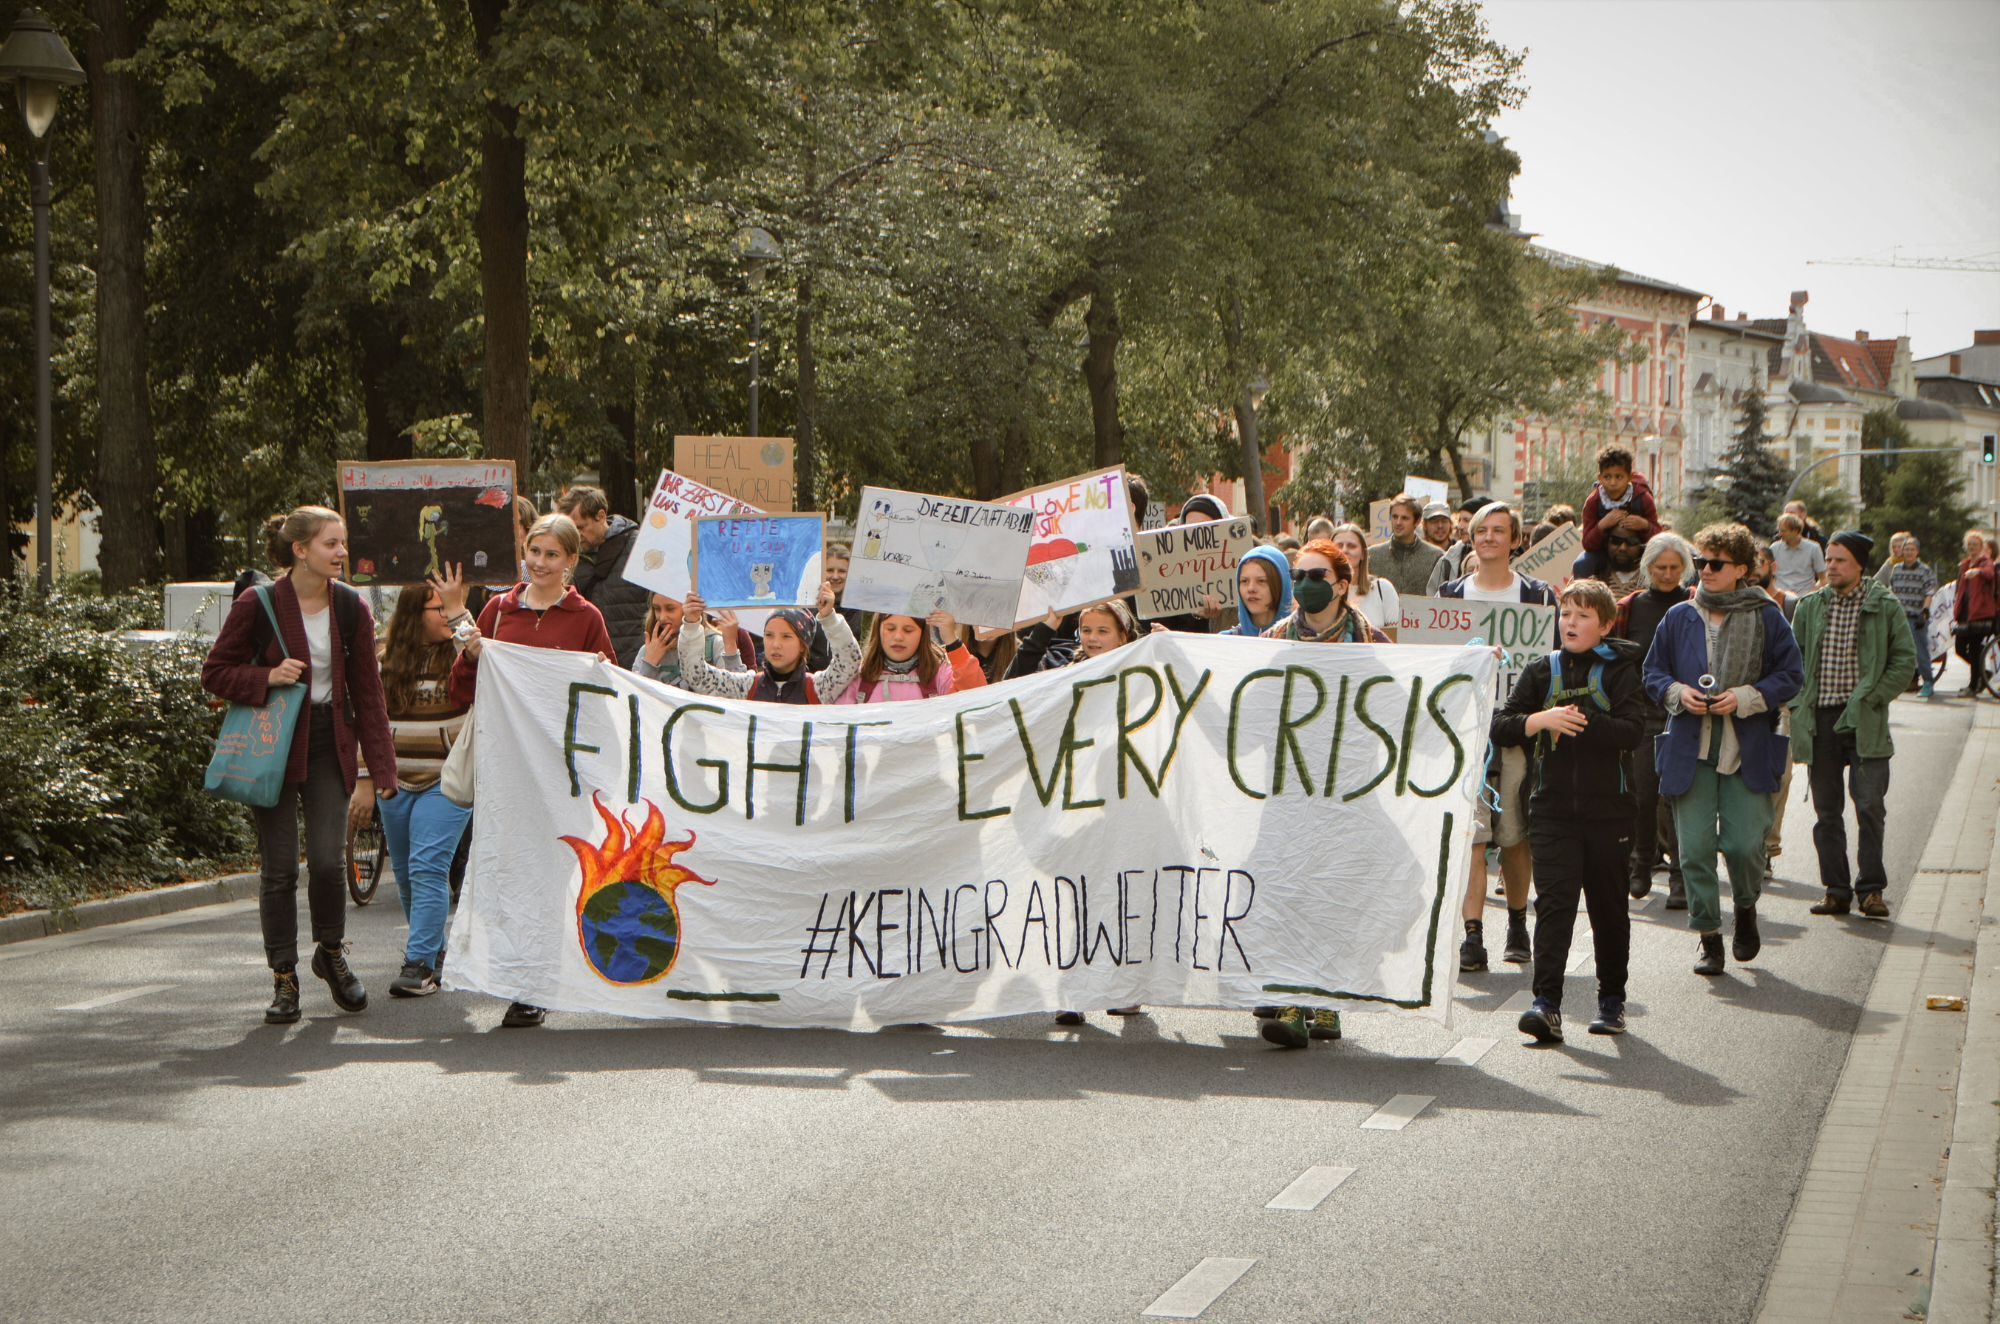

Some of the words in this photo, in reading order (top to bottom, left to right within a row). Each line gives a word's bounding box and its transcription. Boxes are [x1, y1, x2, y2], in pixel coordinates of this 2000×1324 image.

[693, 443, 751, 470] HEAL
[653, 492, 681, 515] UNS
[660, 472, 685, 497] IHR
[680, 481, 762, 515] ZERSTÖR
[726, 476, 793, 504] WORLD
[917, 497, 944, 518] DIE
[941, 504, 974, 525] ZEIT
[1003, 511, 1034, 534] AB!!!
[1146, 504, 1165, 518] US-
[718, 517, 779, 538] RETTE
[1032, 513, 1063, 539] ASTIK
[1155, 530, 1174, 556] NO
[1183, 524, 1220, 553] MORE
[1514, 526, 1581, 575] CHTIGKEIT
[1401, 608, 1420, 629] bis
[1428, 608, 1472, 631] 2035
[1480, 607, 1552, 648] 100%
[257, 711, 271, 721] JU
[258, 721, 272, 732] FO
[260, 733, 273, 744] NA
[563, 682, 893, 826] FIGHT
[956, 663, 1213, 821] EVERY
[1227, 665, 1474, 802] CRISIS
[800, 865, 1256, 981] #KEINGRADWEITER
